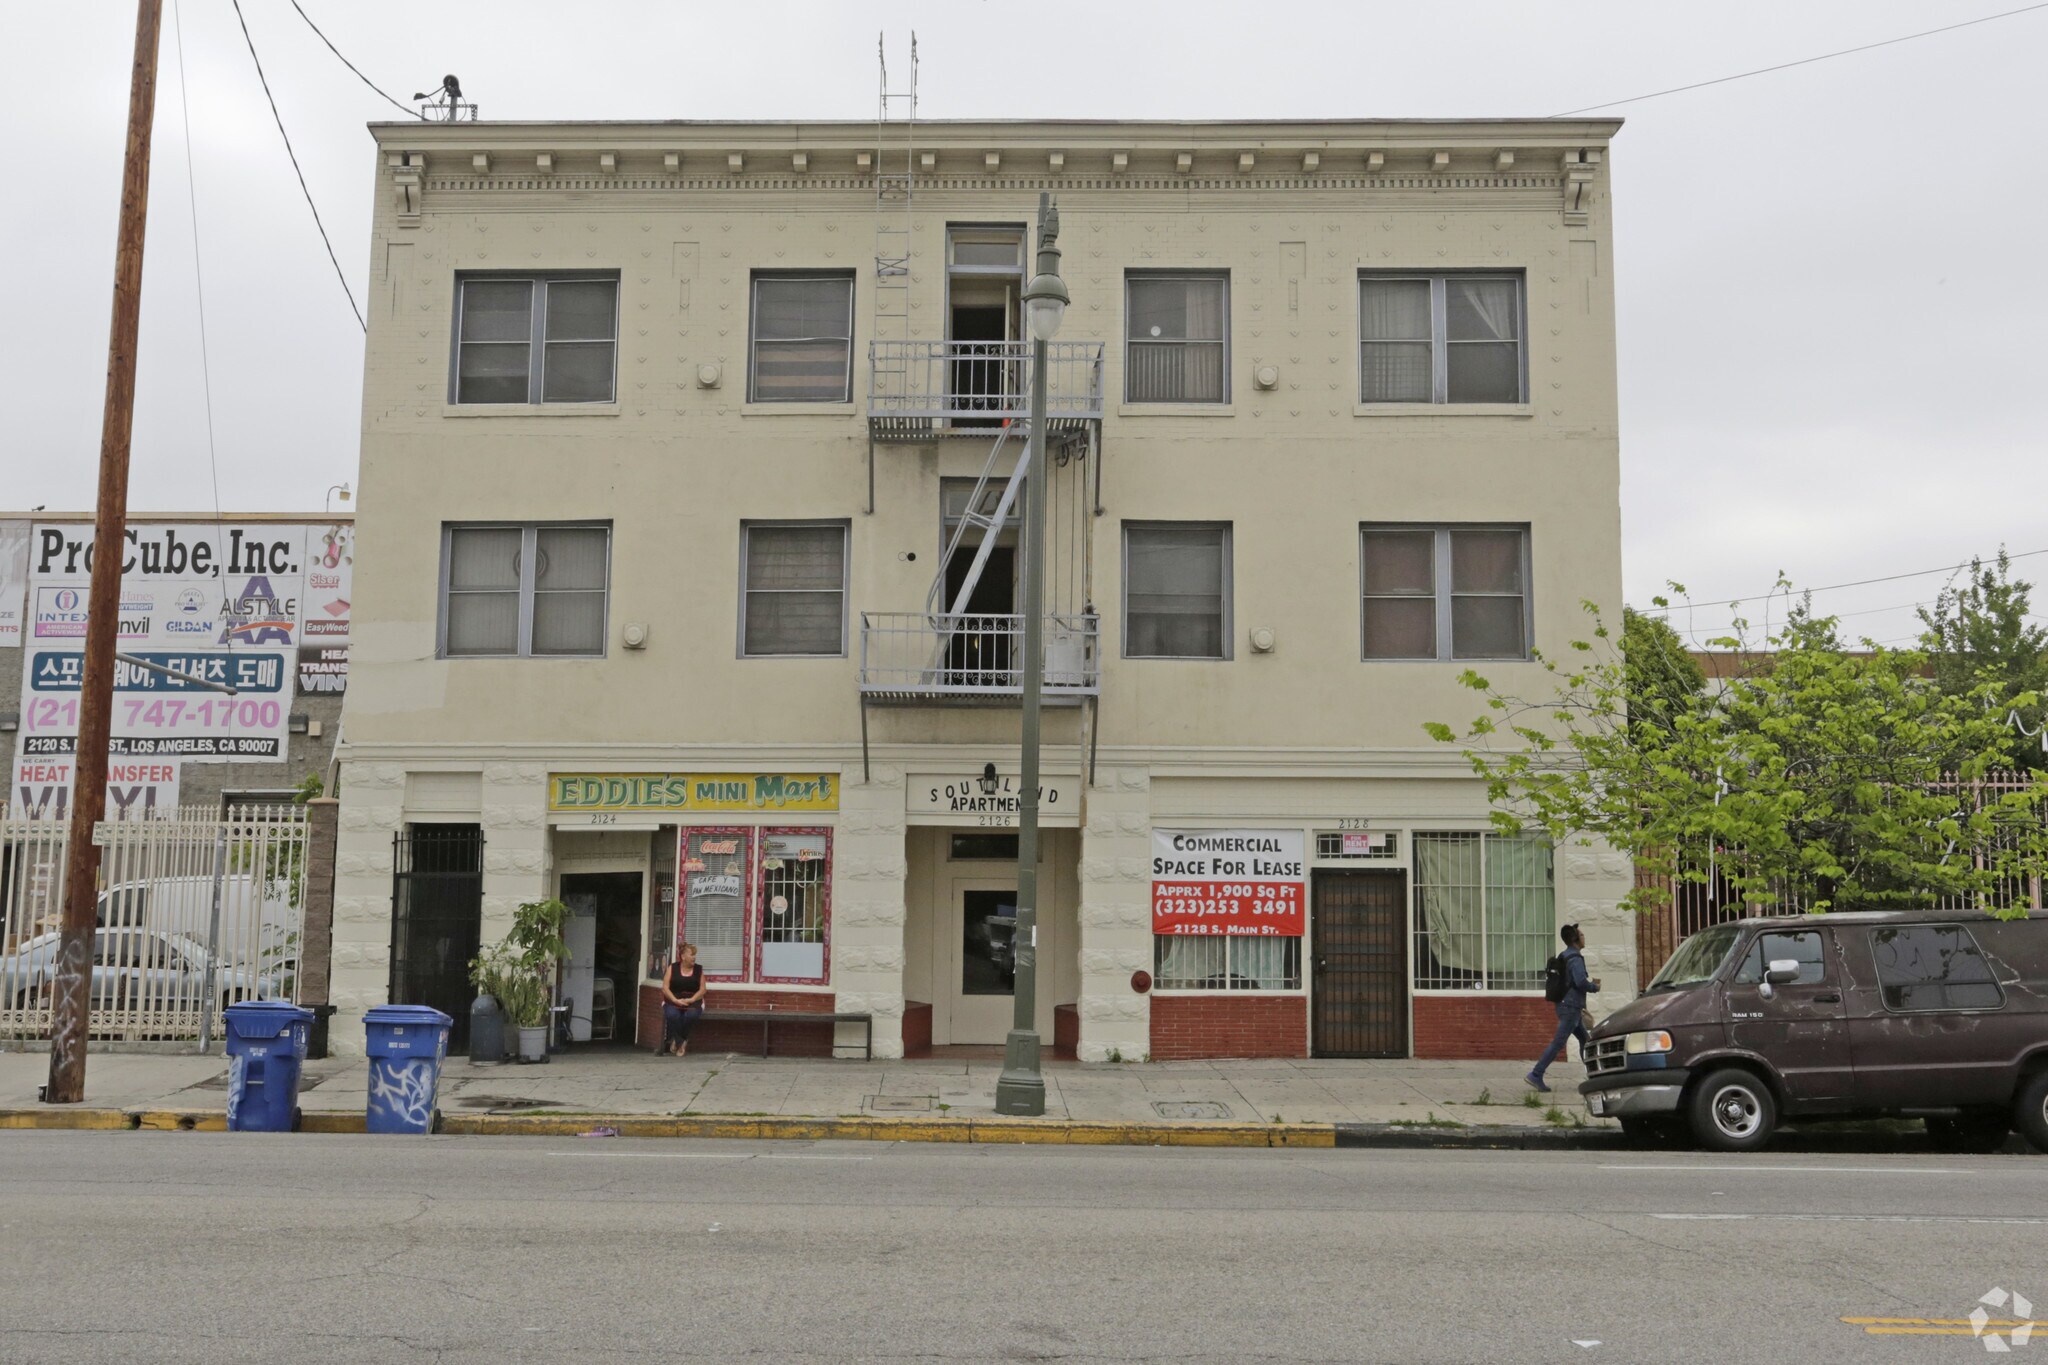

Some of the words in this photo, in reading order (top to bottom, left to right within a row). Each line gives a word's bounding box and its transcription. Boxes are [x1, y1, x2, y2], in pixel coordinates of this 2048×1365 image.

[228, 529, 297, 574] Inc.
[220, 598, 296, 615] ALSTYLE
[117, 617, 150, 633] nvil
[166, 621, 213, 632] GILDAN
[306, 623, 348, 634] EasyWeed
[236, 659, 278, 688] 도매
[124, 699, 280, 728] 747-1700
[28, 739, 58, 752] 2120
[59, 739, 71, 751] S.
[131, 740, 155, 753] LOS
[157, 740, 216, 755] ANGELES,
[219, 740, 237, 752] CA
[238, 740, 275, 753] 90007
[20, 766, 69, 782] HEAT
[556, 775, 687, 807] EDDIE'S
[695, 782, 748, 802] MINI
[754, 775, 832, 808] Mart
[591, 814, 616, 824] 2124
[979, 816, 1011, 826] 2126
[1339, 818, 1369, 829] 2128
[1345, 840, 1368, 848] RENT
[1153, 857, 1205, 875] SPACE
[1212, 858, 1246, 875] FOR
[1253, 859, 1302, 876] LEASE
[698, 875, 717, 884] CAFE
[704, 884, 739, 895] MEXICANO
[1209, 884, 1252, 899] 1,900
[1155, 899, 1239, 917] (323)253
[1253, 900, 1296, 915] 3491
[1174, 924, 1208, 934] 2128
[1211, 925, 1223, 935] S.
[1226, 925, 1258, 935] MAIN
